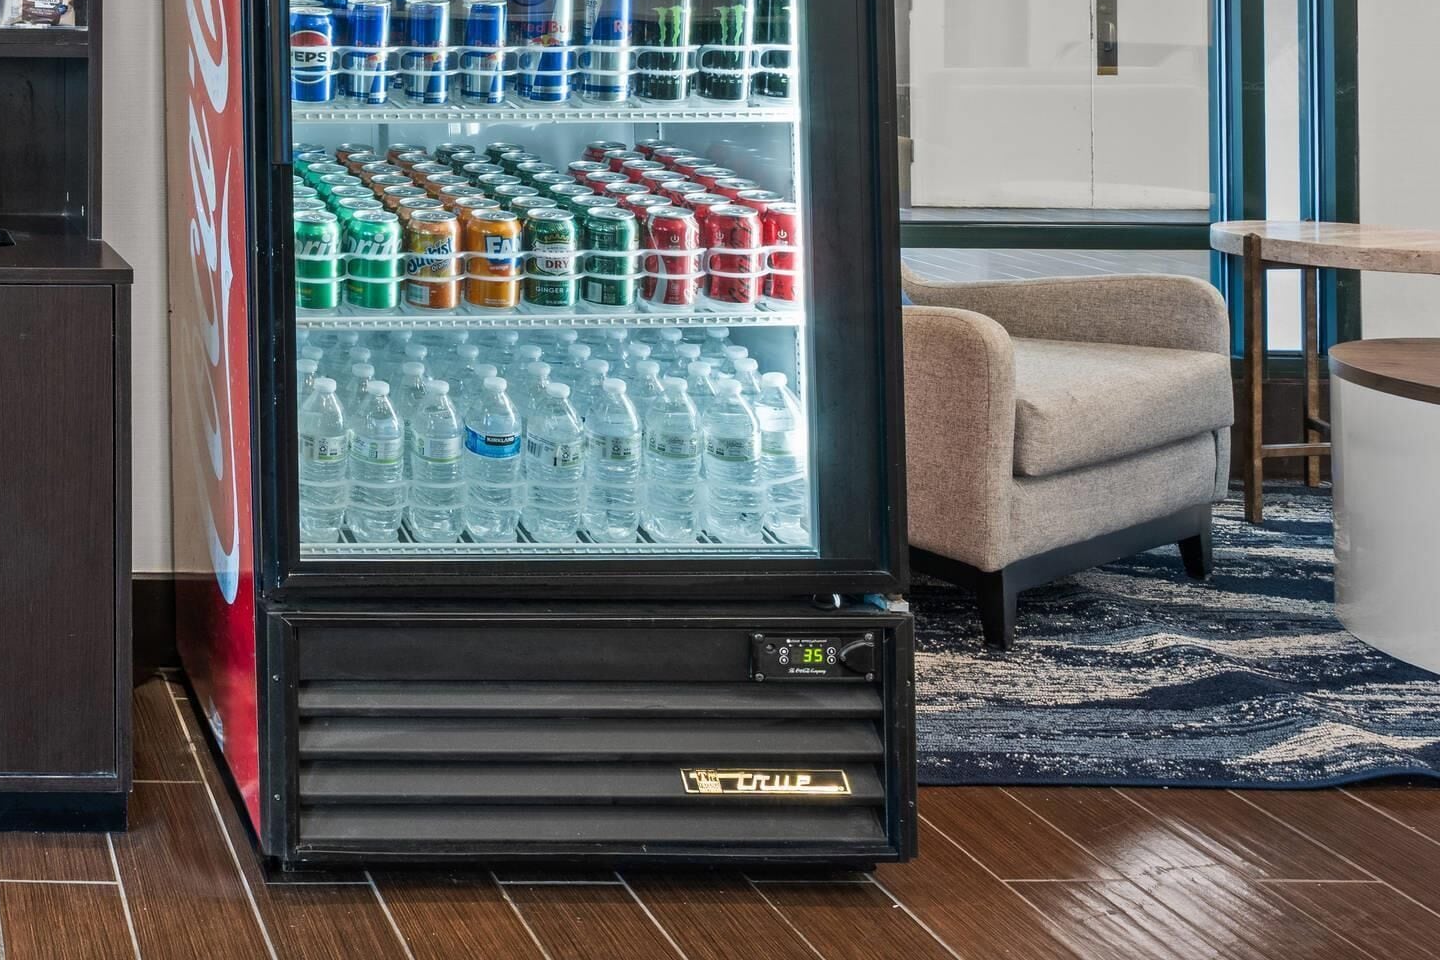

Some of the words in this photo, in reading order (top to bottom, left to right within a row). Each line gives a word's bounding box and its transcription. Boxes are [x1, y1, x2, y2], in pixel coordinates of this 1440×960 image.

[545, 259, 569, 269] DRY
[535, 286, 564, 294] GINGER
[803, 648, 823, 662] 35
